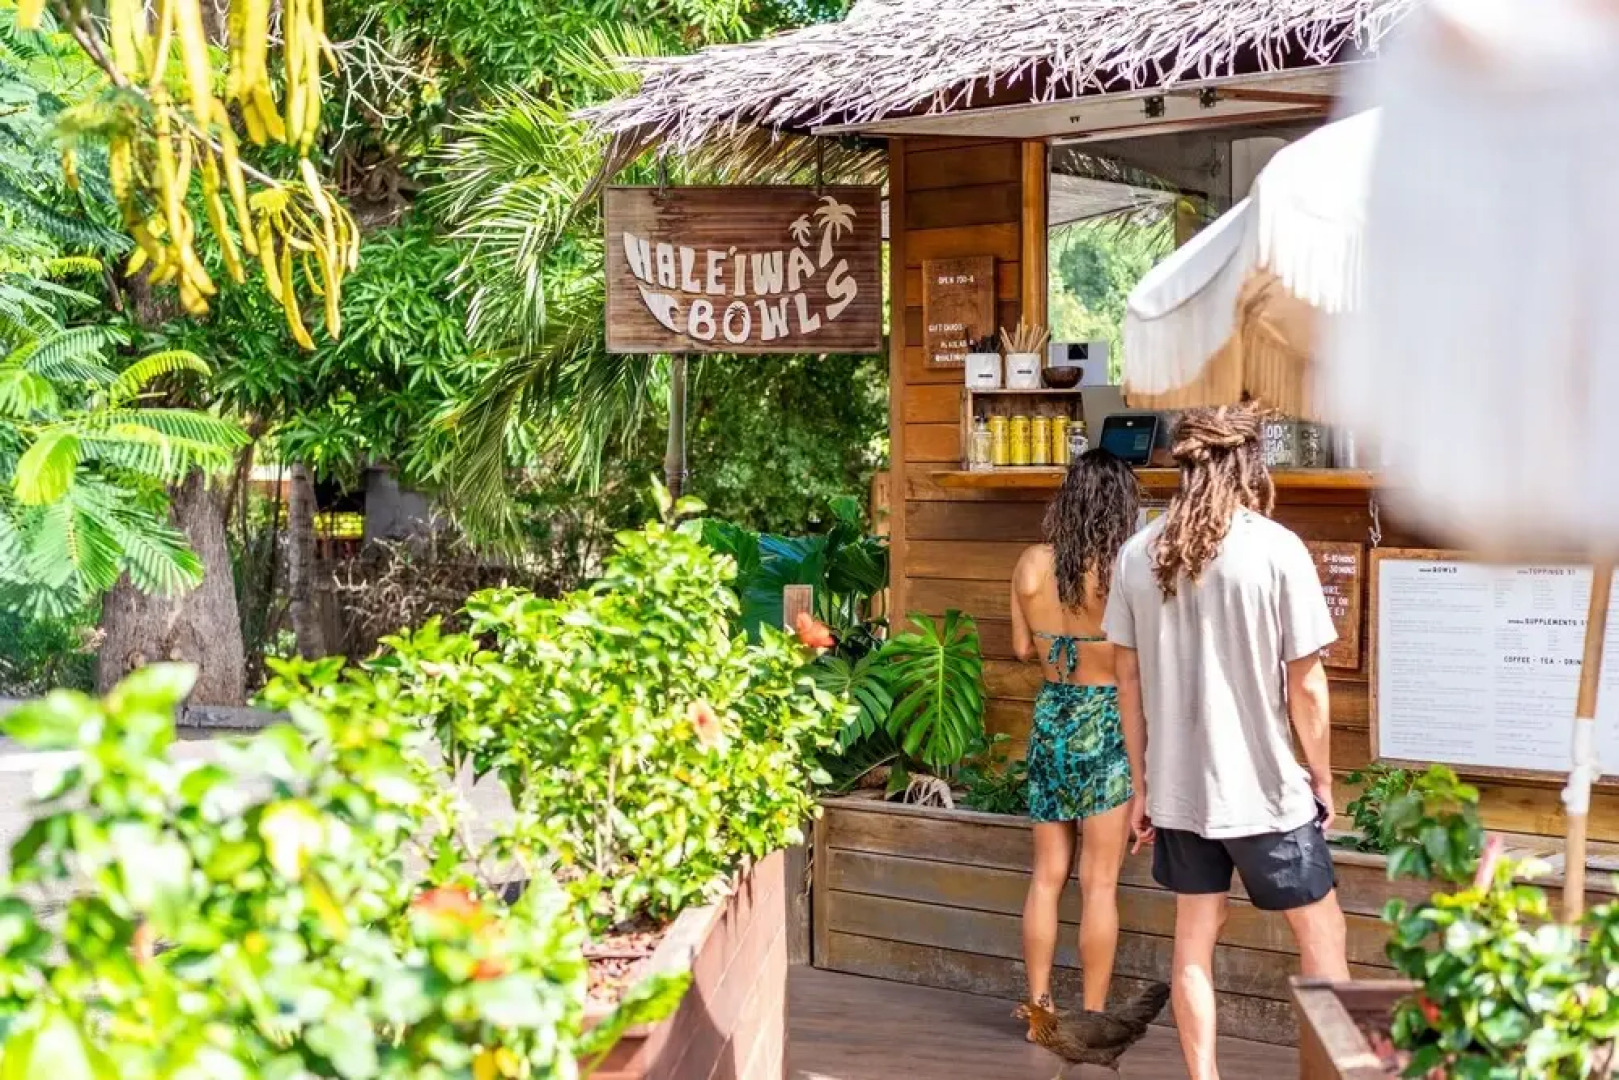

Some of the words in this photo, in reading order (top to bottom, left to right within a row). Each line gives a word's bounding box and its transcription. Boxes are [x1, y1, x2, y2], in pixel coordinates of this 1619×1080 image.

[688, 258, 858, 344] BOWLS
[1432, 566, 1458, 574] BOWLS
[1528, 567, 1565, 576] TOPPINGS
[1524, 618, 1577, 626] SUPPLEMENTS
[1503, 656, 1530, 664] COFFEE
[1540, 656, 1555, 665] TEA
